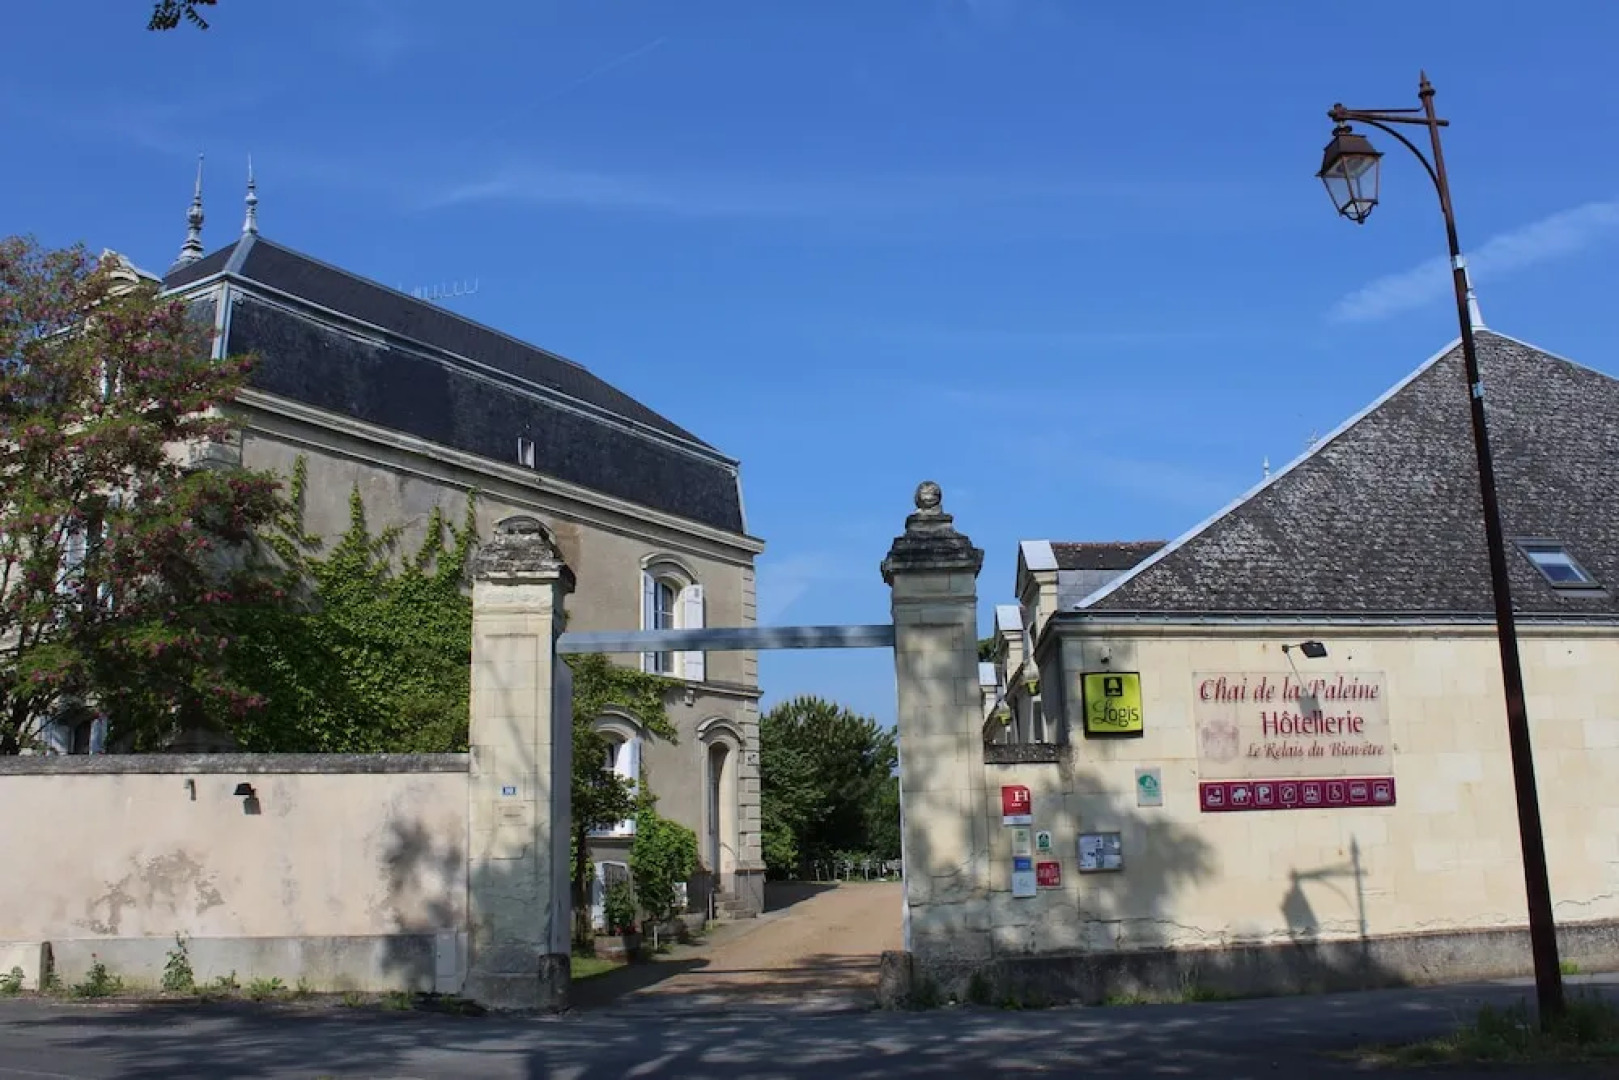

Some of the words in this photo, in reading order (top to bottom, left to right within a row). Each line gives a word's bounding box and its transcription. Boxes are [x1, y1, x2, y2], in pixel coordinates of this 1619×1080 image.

[1200, 677, 1247, 702] Chai
[1254, 677, 1275, 702] de
[1282, 676, 1300, 701] la
[1307, 675, 1379, 701] Paleine
[1092, 699, 1139, 727] Logis
[1260, 709, 1364, 736] Hôtellerie
[1246, 742, 1261, 758] Le
[1263, 741, 1303, 760] Relais
[1307, 740, 1324, 757] du
[1014, 790, 1029, 802] H
